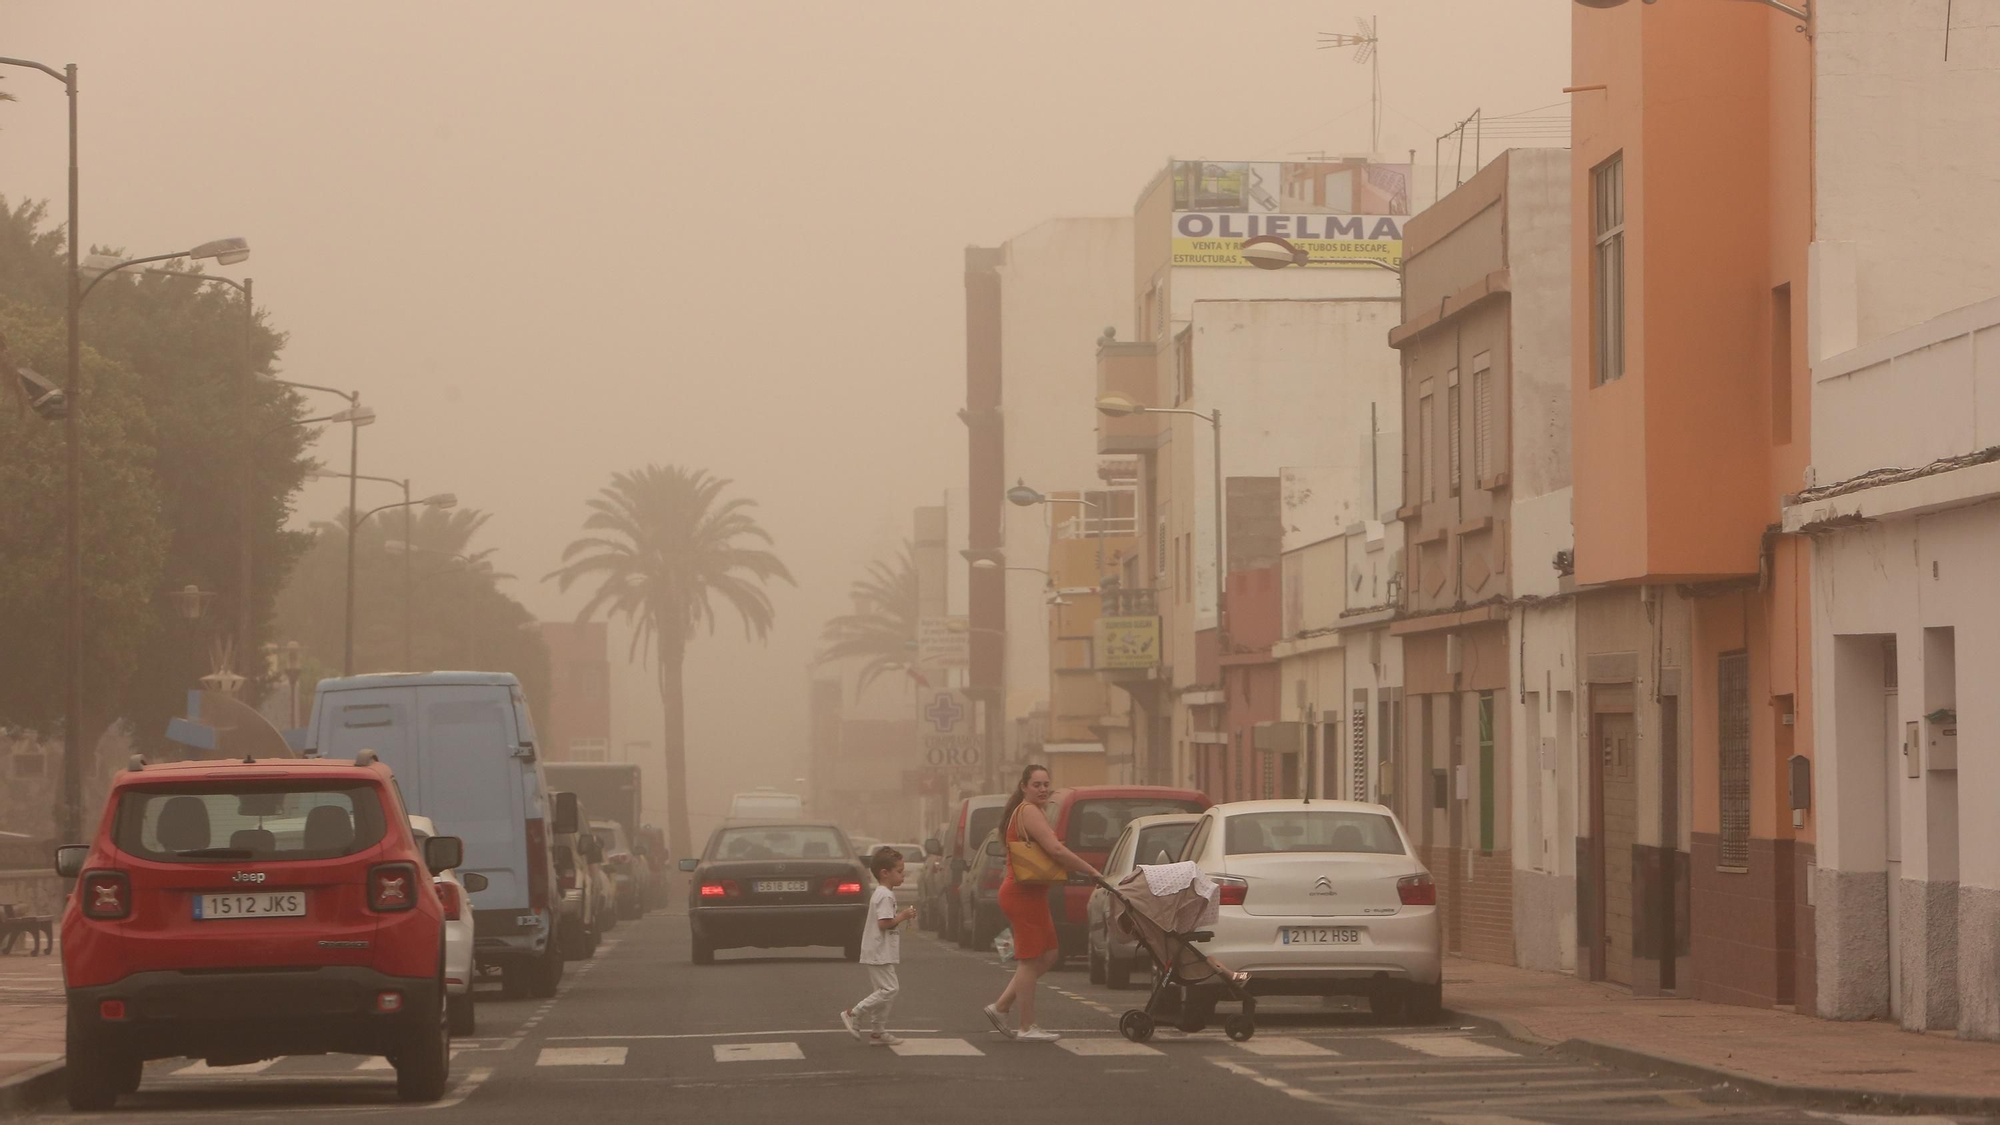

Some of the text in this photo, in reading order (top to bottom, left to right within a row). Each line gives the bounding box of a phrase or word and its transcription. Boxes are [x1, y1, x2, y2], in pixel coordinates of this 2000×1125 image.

[1178, 214, 1404, 240] OLIELMA
[1192, 241, 1222, 251] VENTA
[1225, 241, 1231, 250] Y
[1294, 243, 1306, 251] DE
[1308, 243, 1337, 252] TUBOS
[1340, 243, 1351, 252] DE
[1354, 244, 1390, 254] ESCAPE,
[927, 747, 979, 765] ORO
[232, 870, 266, 883] Jeep
[212, 896, 297, 914] 1512 JKS
[1291, 929, 1358, 943] 2112 HSB
